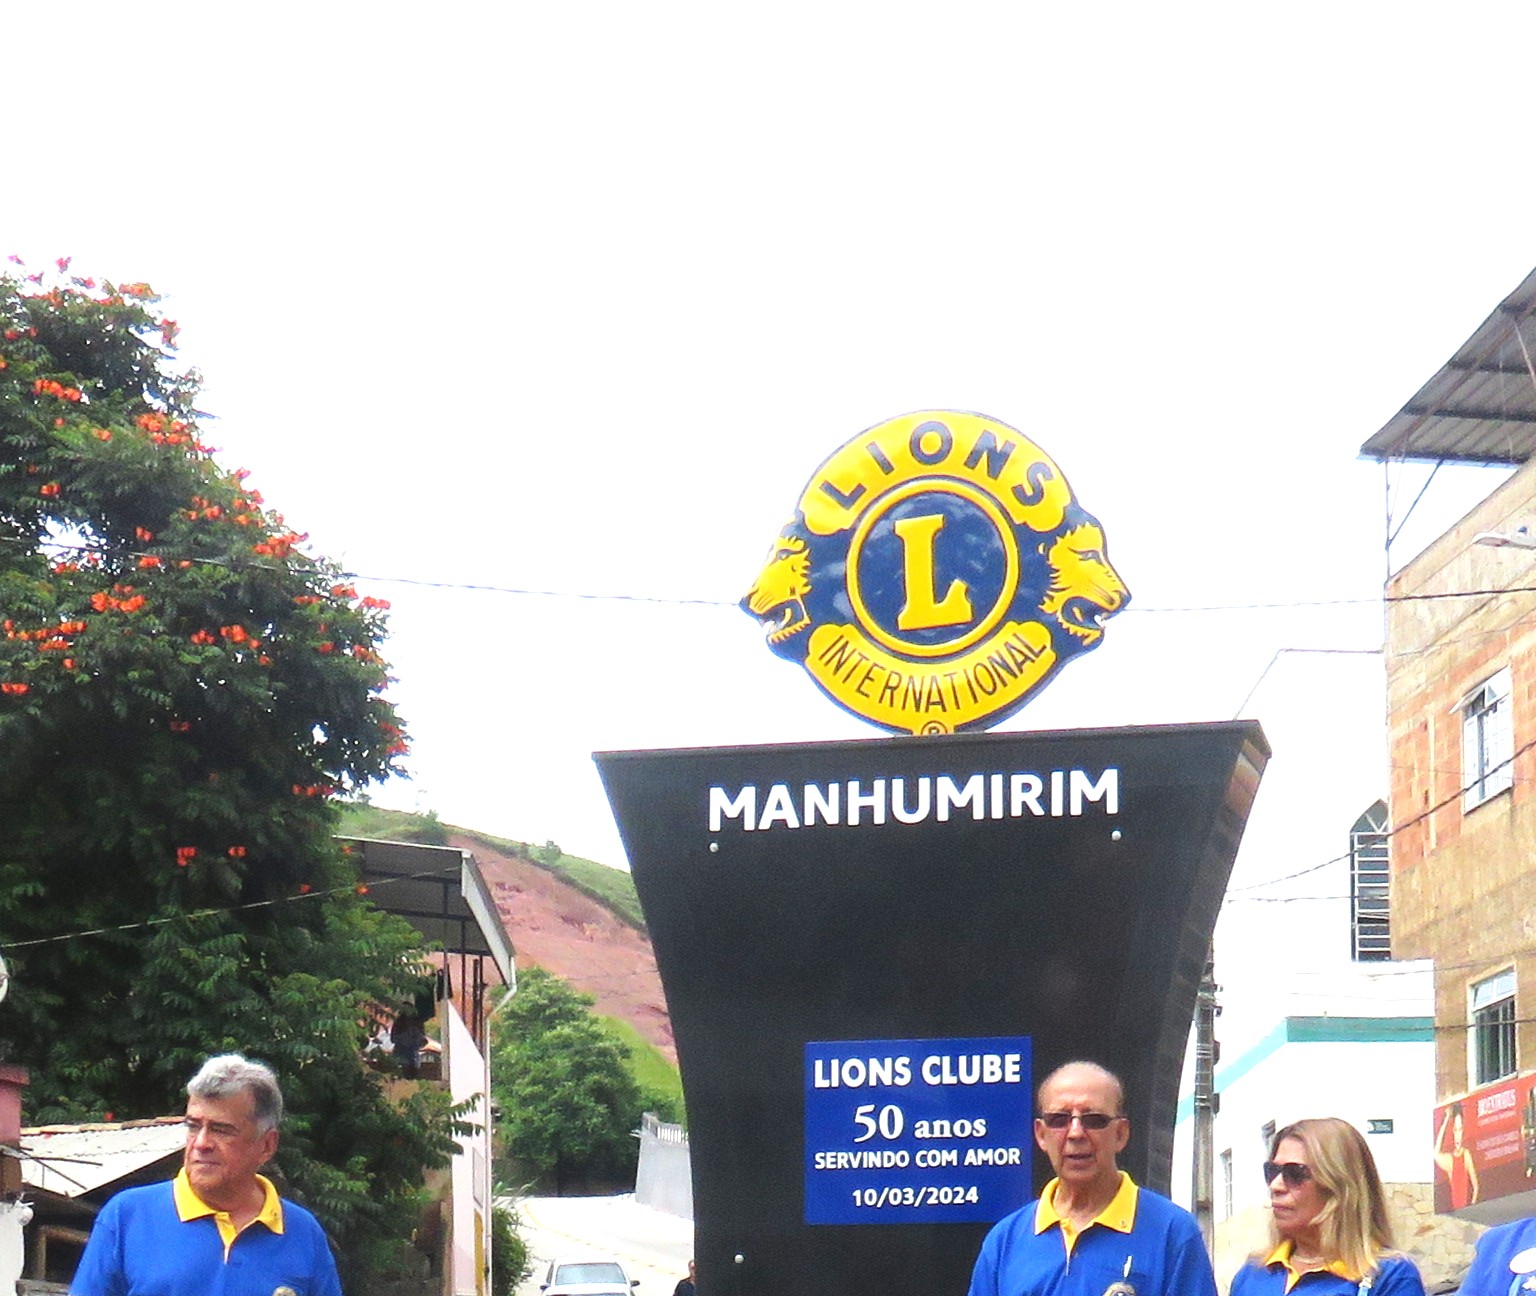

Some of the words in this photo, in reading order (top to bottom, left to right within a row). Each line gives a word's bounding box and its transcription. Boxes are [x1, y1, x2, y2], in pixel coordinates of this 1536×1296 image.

[819, 420, 1053, 510] LIONS
[893, 513, 974, 631] L
[818, 632, 1048, 714] INTERNATIONAL
[708, 767, 1120, 833] MANHUMIRIM
[814, 1056, 912, 1088] LIONS
[921, 1053, 1022, 1085] CLUBE
[853, 1103, 905, 1143] 50
[913, 1116, 988, 1139] anos
[814, 1150, 910, 1170] SERVINDO
[914, 1149, 958, 1168] COM
[963, 1148, 1022, 1167] AMOR
[851, 1186, 980, 1208] 10/03/2024
